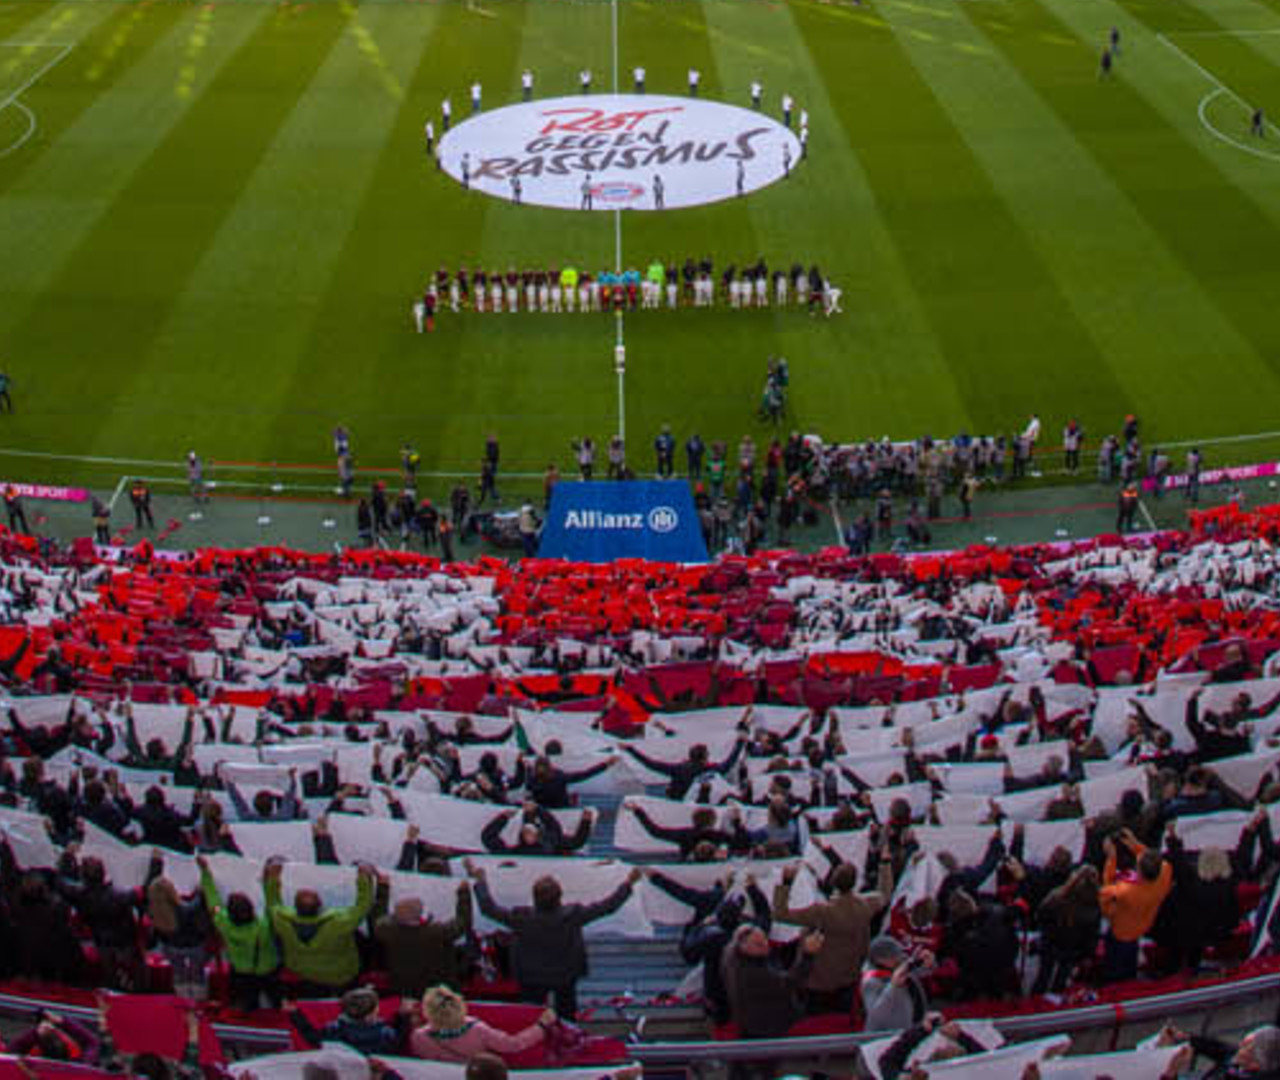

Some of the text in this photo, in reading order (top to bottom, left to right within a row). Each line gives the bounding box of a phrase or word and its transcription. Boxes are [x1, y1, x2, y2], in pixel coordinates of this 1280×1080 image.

[471, 126, 773, 182] RASSISMUS
[524, 119, 670, 154] GEGEN
[564, 509, 644, 529] Allianz
